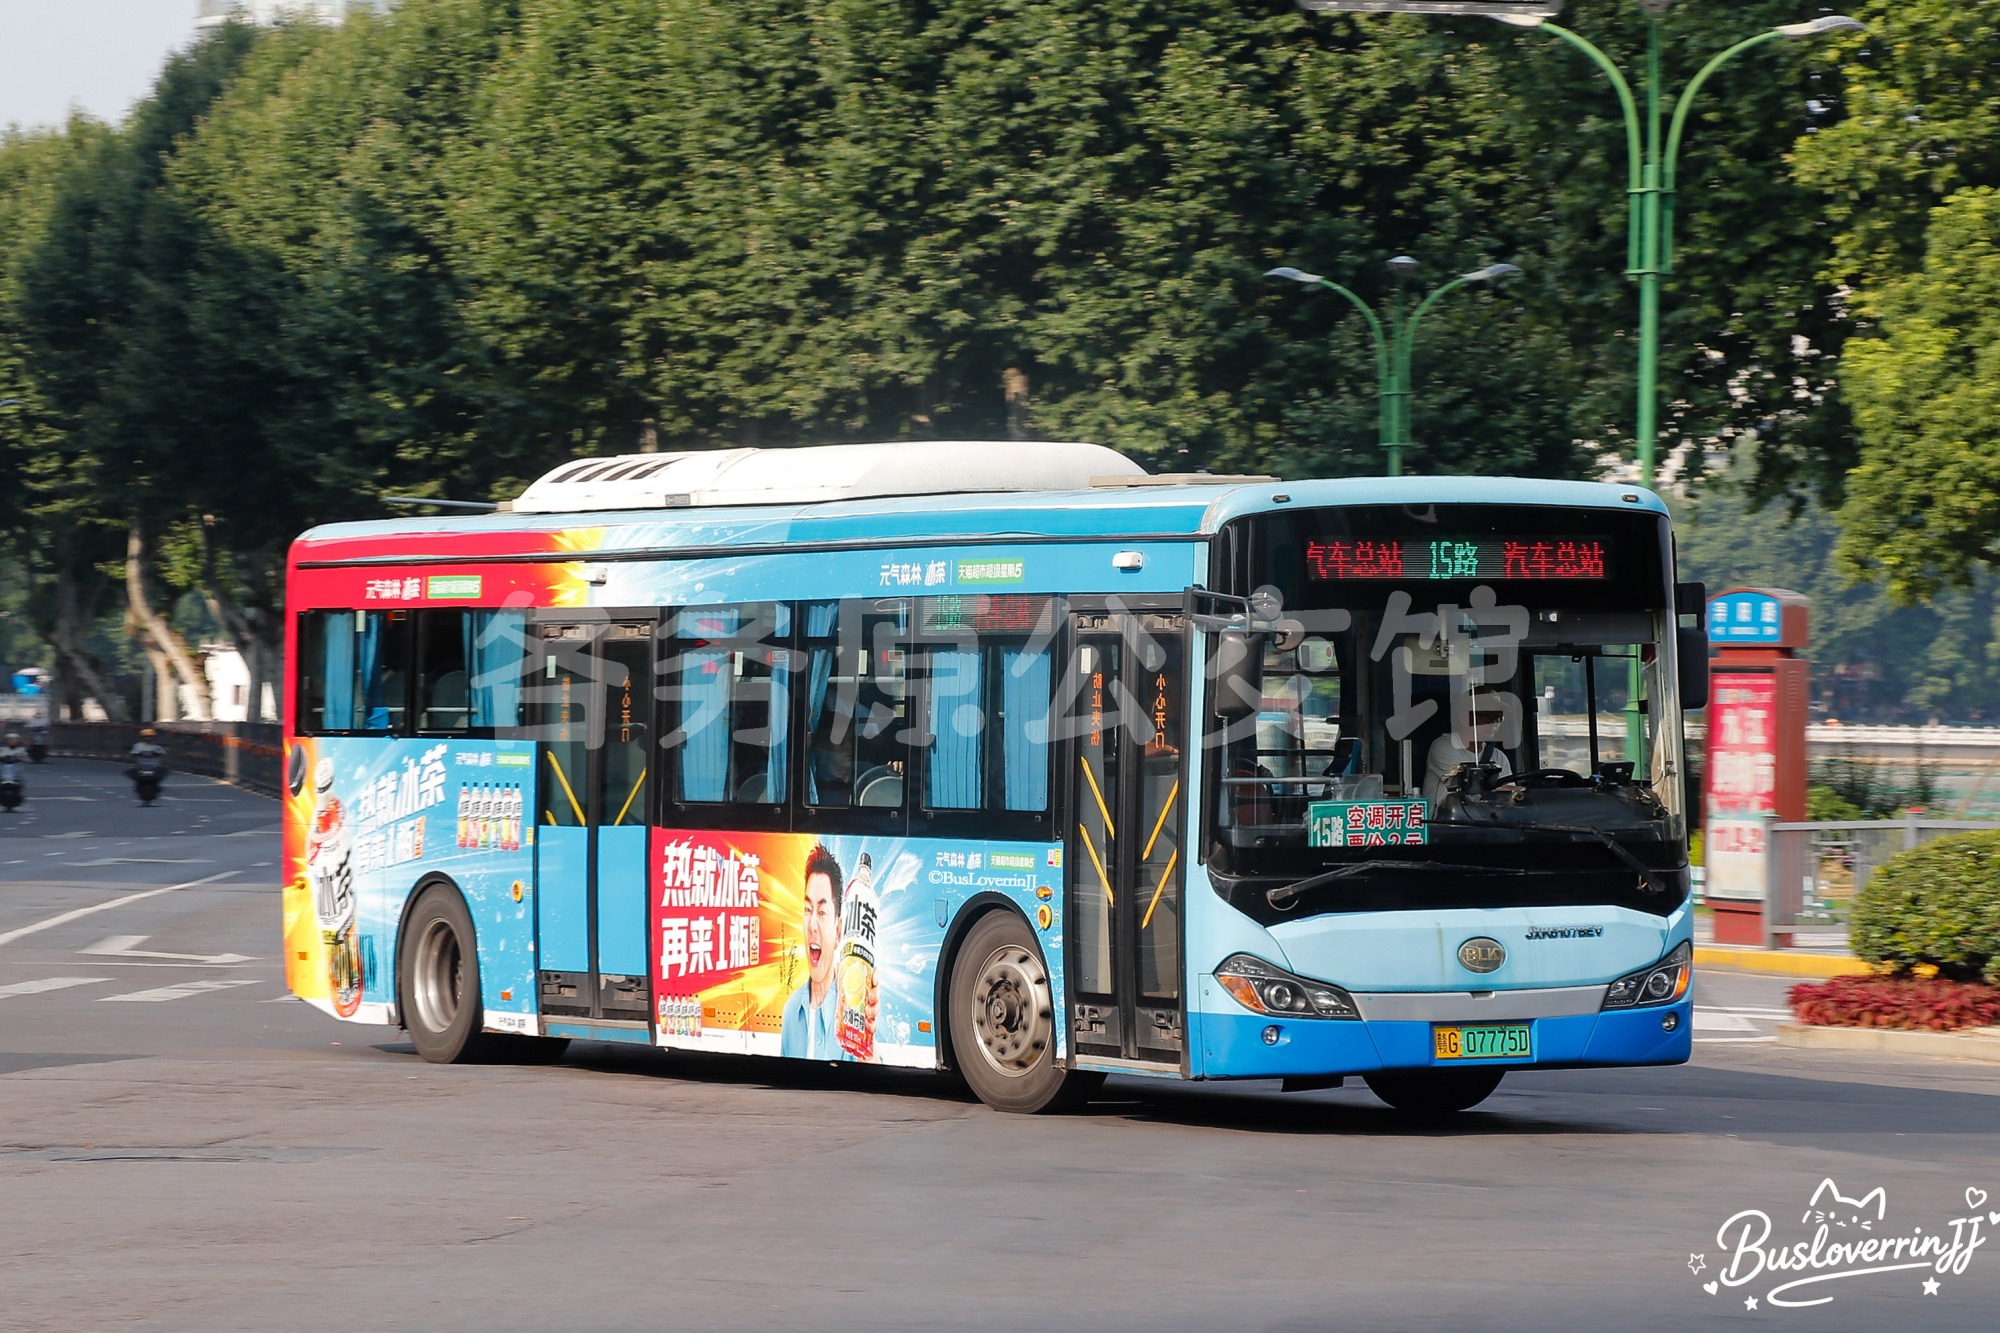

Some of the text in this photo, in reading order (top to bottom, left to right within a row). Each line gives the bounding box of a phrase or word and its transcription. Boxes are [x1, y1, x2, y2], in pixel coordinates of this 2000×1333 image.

[880, 562, 922, 586] 元气森林
[1429, 541, 1478, 579] 15路
[1504, 541, 1604, 579] 汽车总站
[1313, 816, 1344, 847] 15路
[1347, 803, 1425, 830] 空调开启
[661, 835, 760, 908] 热就冰茶
[660, 911, 751, 981] 再来1瓶
[1466, 1029, 1529, 1053] 07775D
